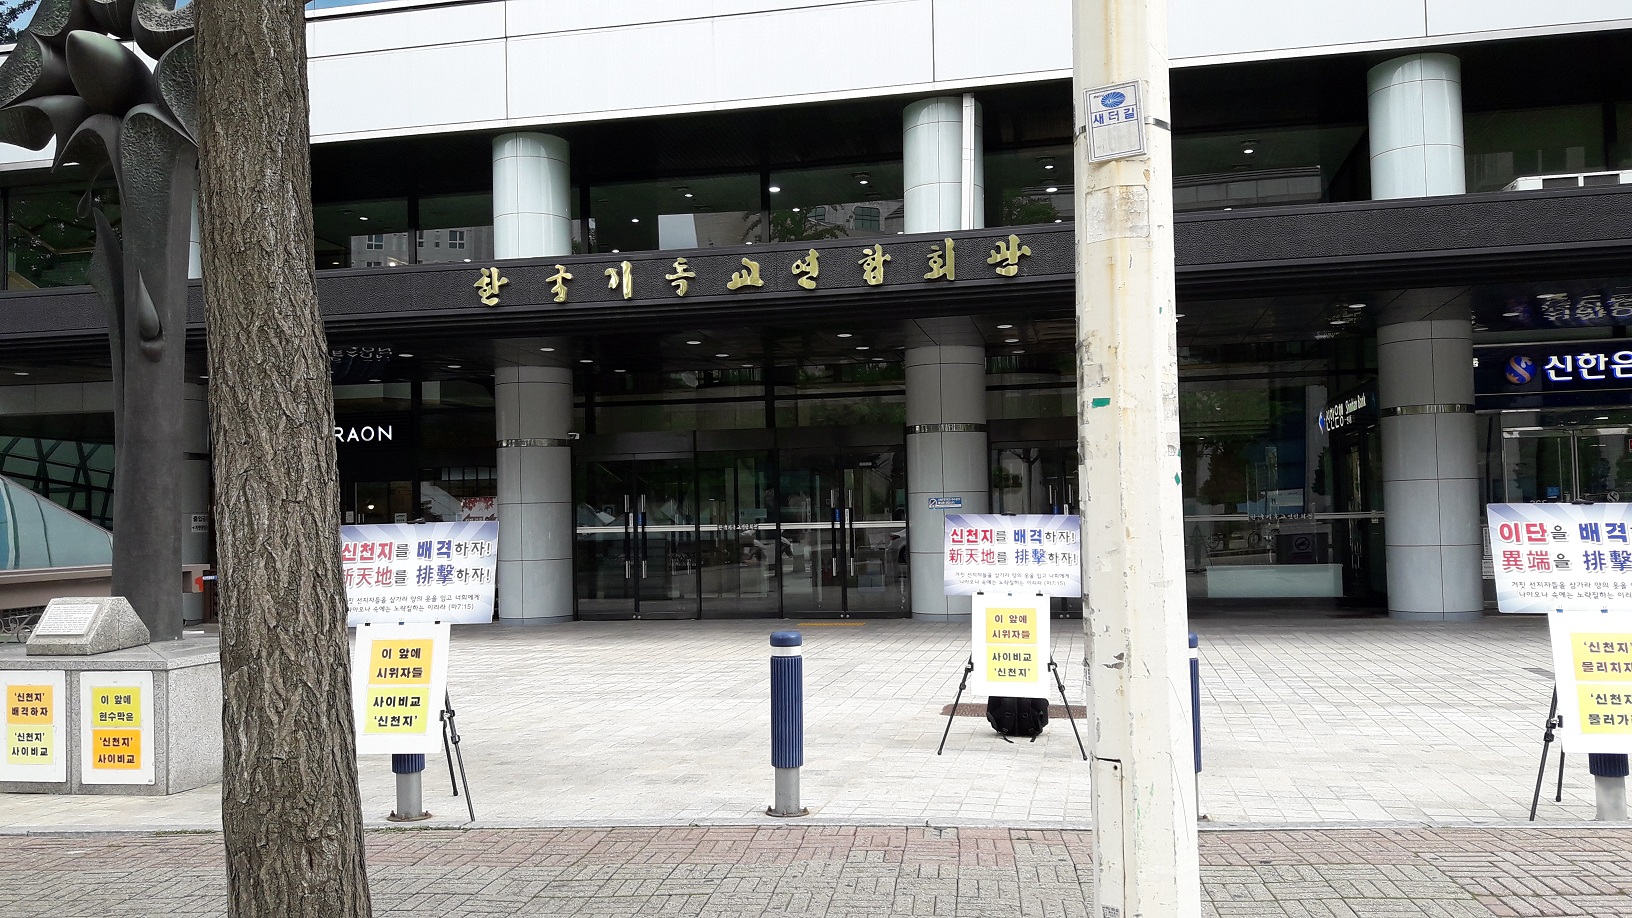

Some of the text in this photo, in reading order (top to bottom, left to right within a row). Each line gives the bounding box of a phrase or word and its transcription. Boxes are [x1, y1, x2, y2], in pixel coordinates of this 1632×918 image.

[1093, 107, 1135, 124] 새터길
[473, 234, 1031, 306] 한국기독교연합회관
[950, 528, 1077, 544] 신천지를 배격하자!
[1499, 523, 1568, 543] 이단을
[1579, 523, 1632, 543] 배격
[342, 540, 491, 561] 신천지를 배격하자!
[948, 547, 1077, 565] 新天地를 排擊하자!
[1502, 550, 1571, 571] 異端을
[416, 564, 490, 584] 排擊하자!
[994, 615, 1027, 624] 이 앞에
[992, 630, 1030, 639] 시위자들
[382, 648, 421, 659] 이 앞에
[992, 653, 1032, 662] 사이비교
[376, 667, 423, 678] 시위자들
[100, 695, 131, 705] 이 앞에
[373, 696, 421, 707] 사이비교
[11, 707, 48, 717] 배격하자
[99, 712, 134, 722] 현수막은
[1588, 714, 1632, 726] 물러가
[11, 747, 48, 757] 사이비교
[97, 754, 135, 764] 사이비교
